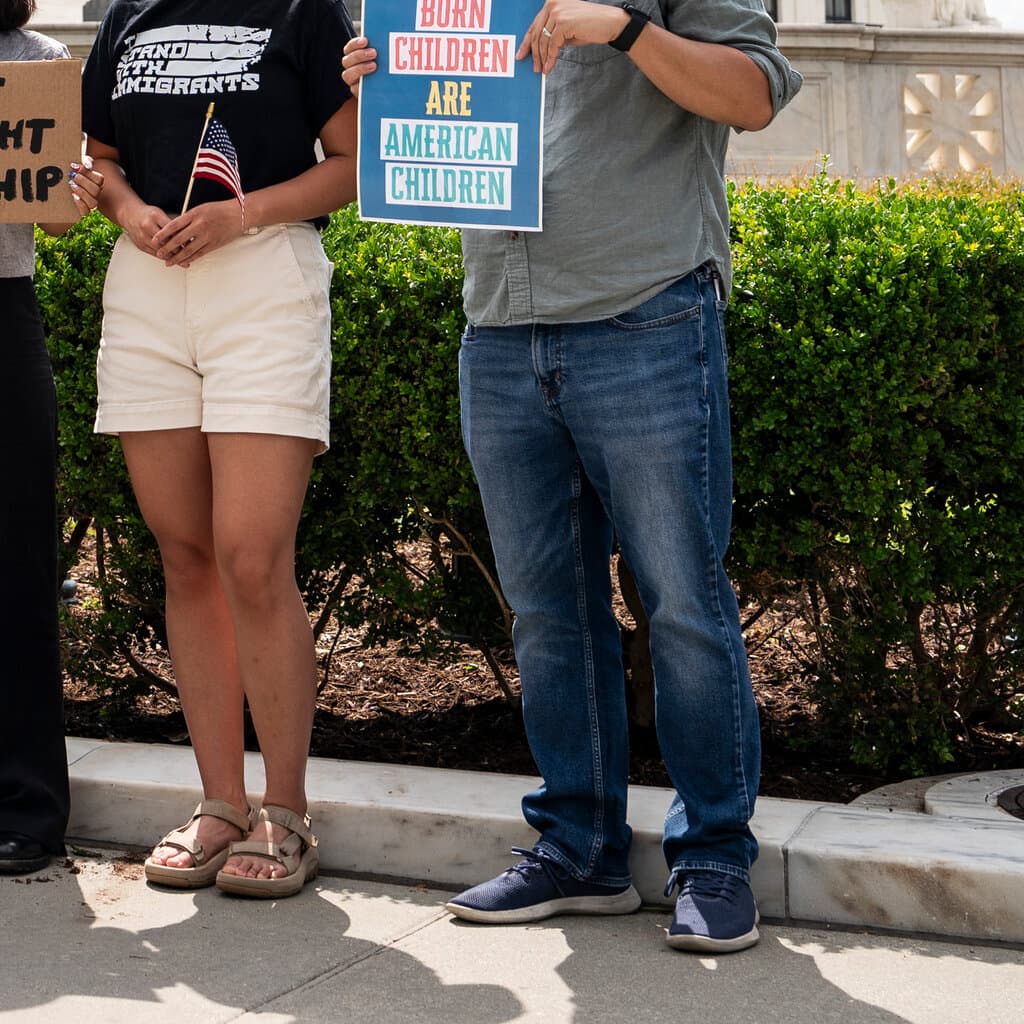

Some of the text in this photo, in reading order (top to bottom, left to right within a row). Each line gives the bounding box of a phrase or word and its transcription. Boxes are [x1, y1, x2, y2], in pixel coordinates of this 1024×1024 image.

[394, 36, 509, 73] CHILDREN
[112, 73, 260, 101] IMMIGRANTS
[425, 80, 472, 116] ARE
[384, 123, 512, 162] AMERICAN
[391, 166, 505, 205] CHILDREN
